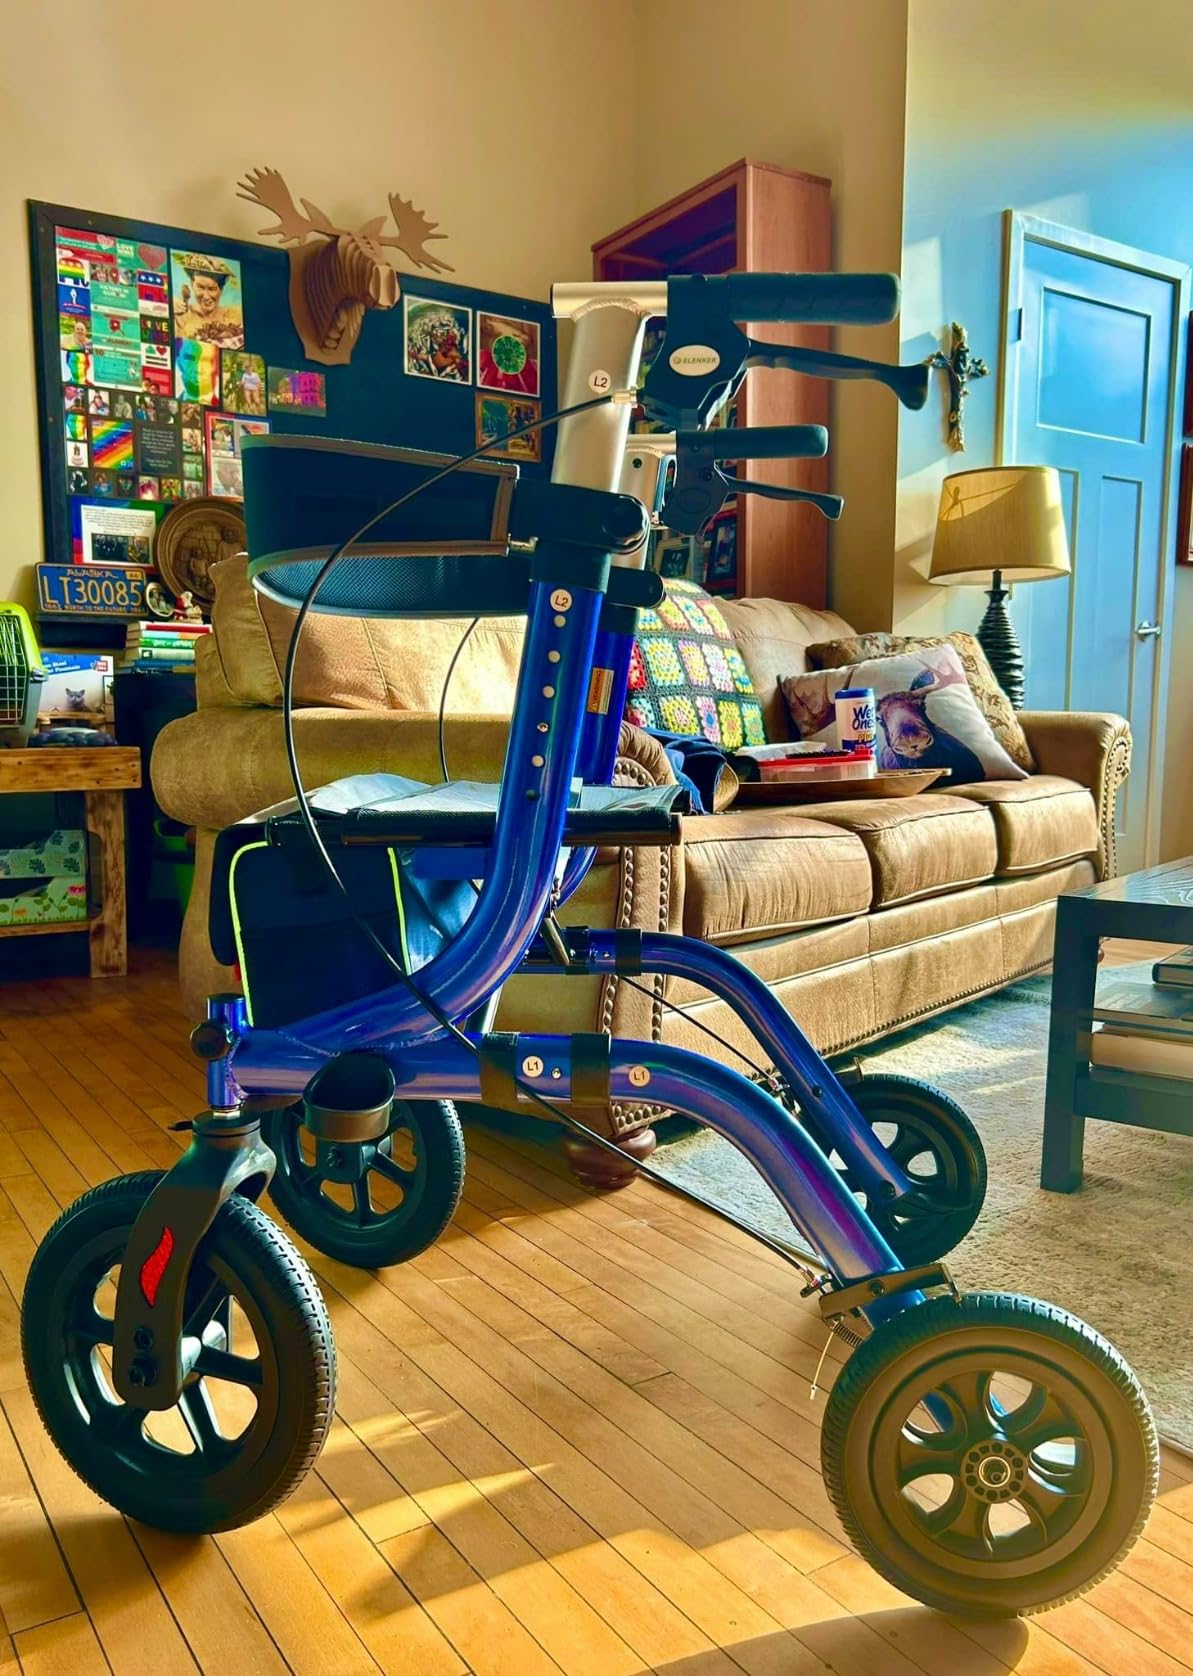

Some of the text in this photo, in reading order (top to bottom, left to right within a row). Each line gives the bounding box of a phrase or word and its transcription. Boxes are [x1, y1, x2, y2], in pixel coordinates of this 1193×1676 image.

[683, 356, 716, 364] ELENKER
[594, 375, 608, 388] L2
[66, 568, 119, 579] ALASKA
[43, 575, 142, 606] LT30085
[554, 594, 569, 608] L2
[527, 1061, 539, 1072] L1
[633, 1070, 645, 1081] L1
